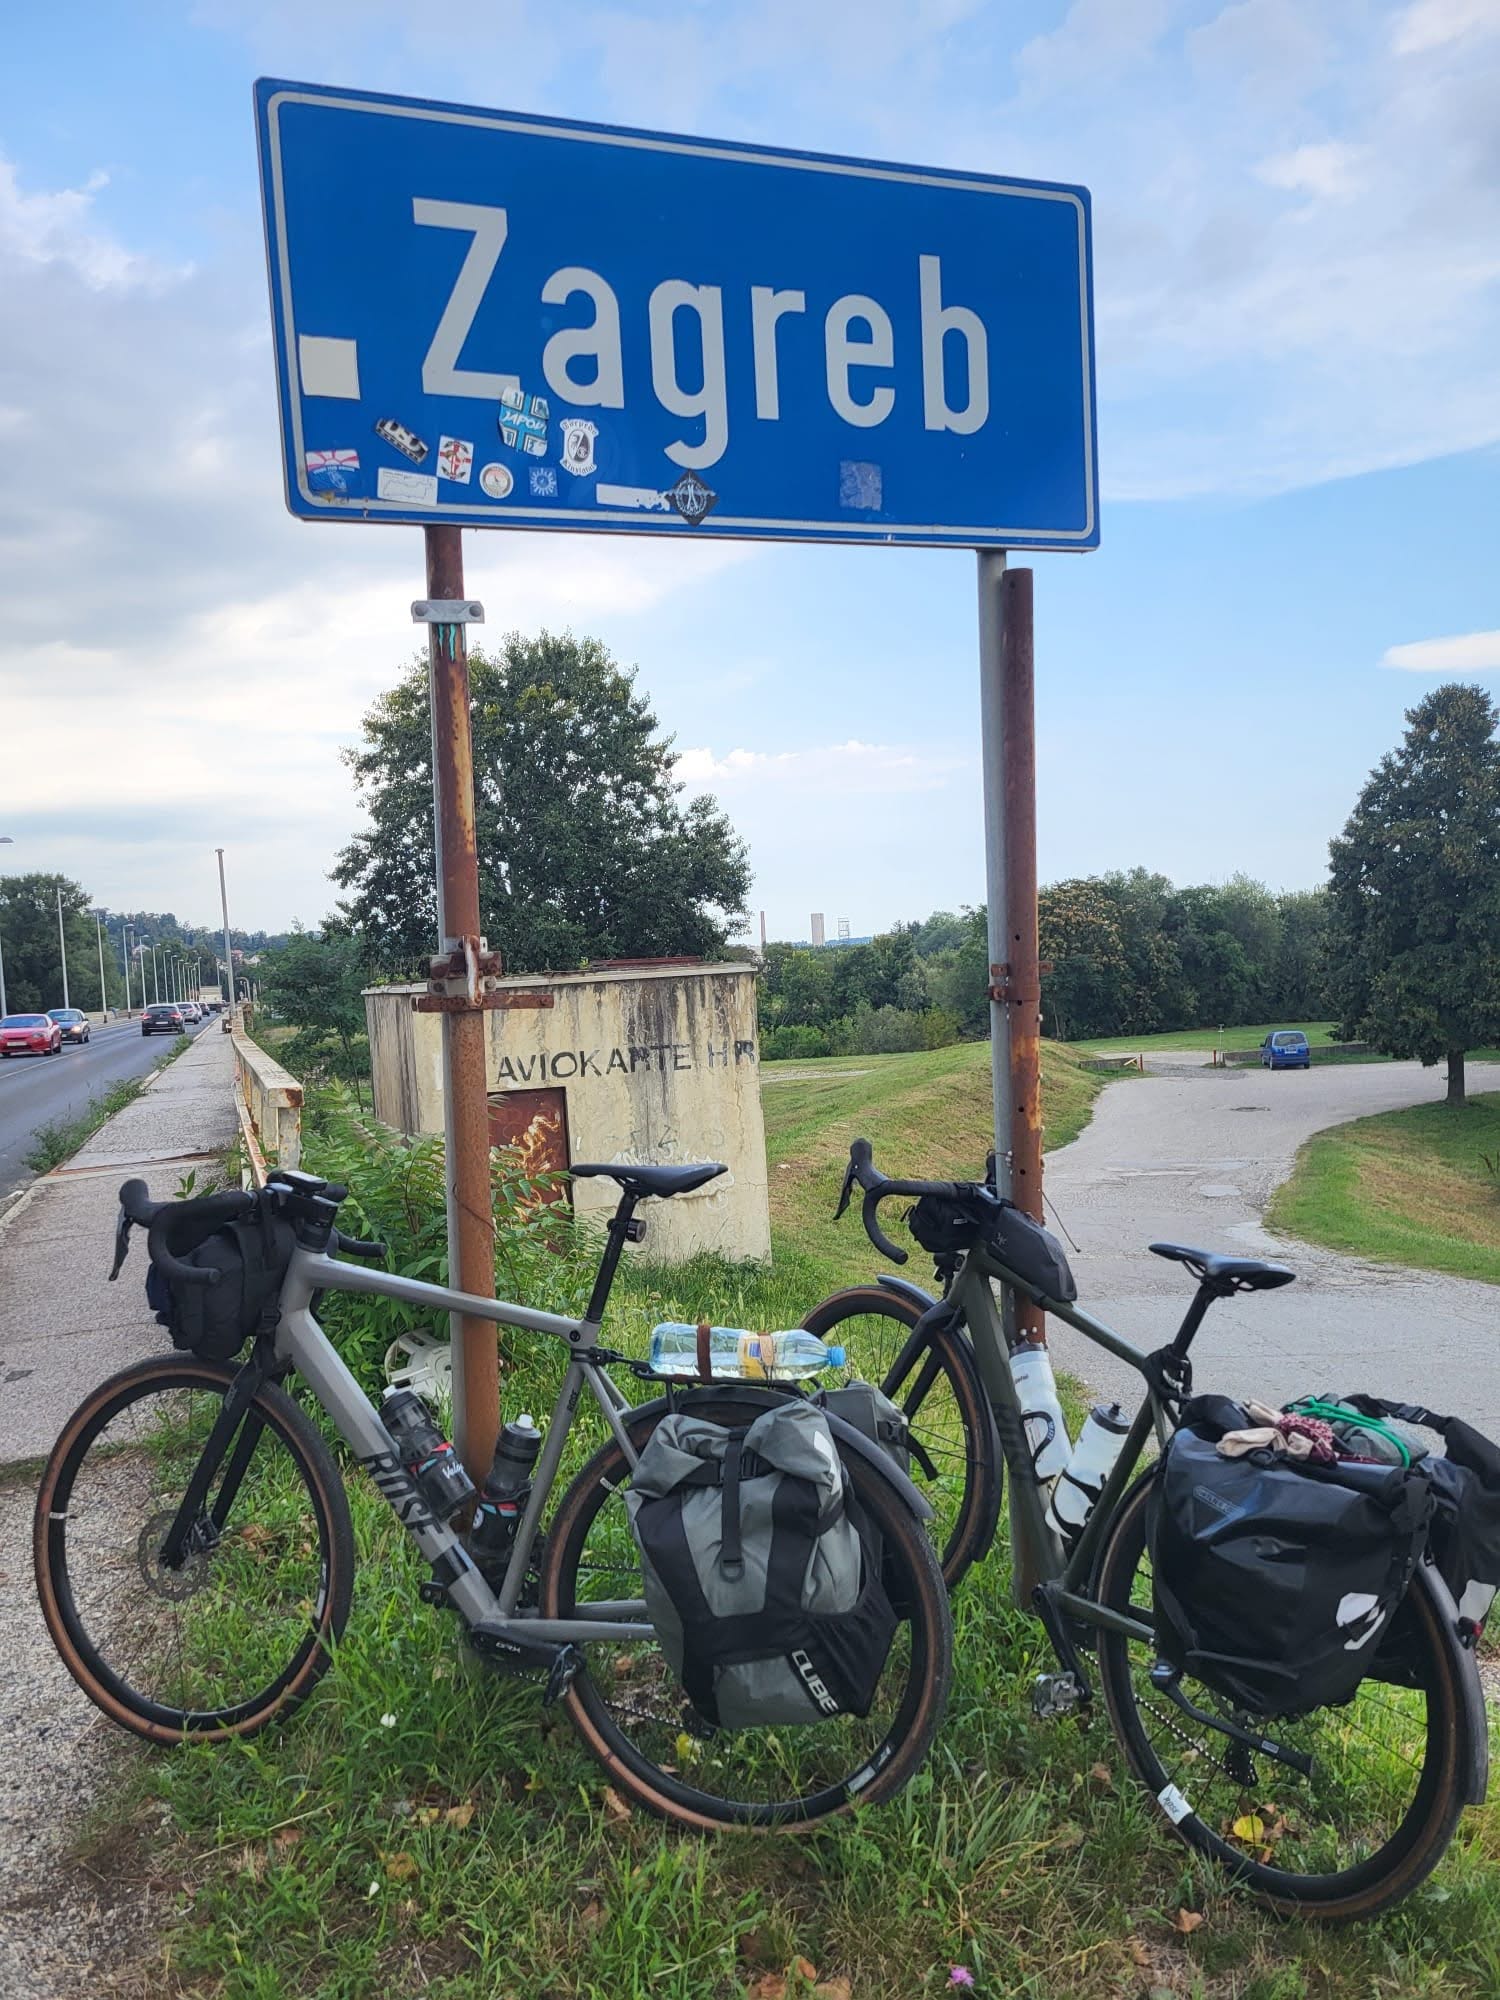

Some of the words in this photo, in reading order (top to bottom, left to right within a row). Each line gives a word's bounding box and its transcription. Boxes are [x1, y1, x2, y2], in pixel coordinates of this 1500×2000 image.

[412, 197, 991, 470] Zagreb
[498, 1043, 691, 1084] AVIOKARTE
[792, 1650, 839, 1714] CUBE
